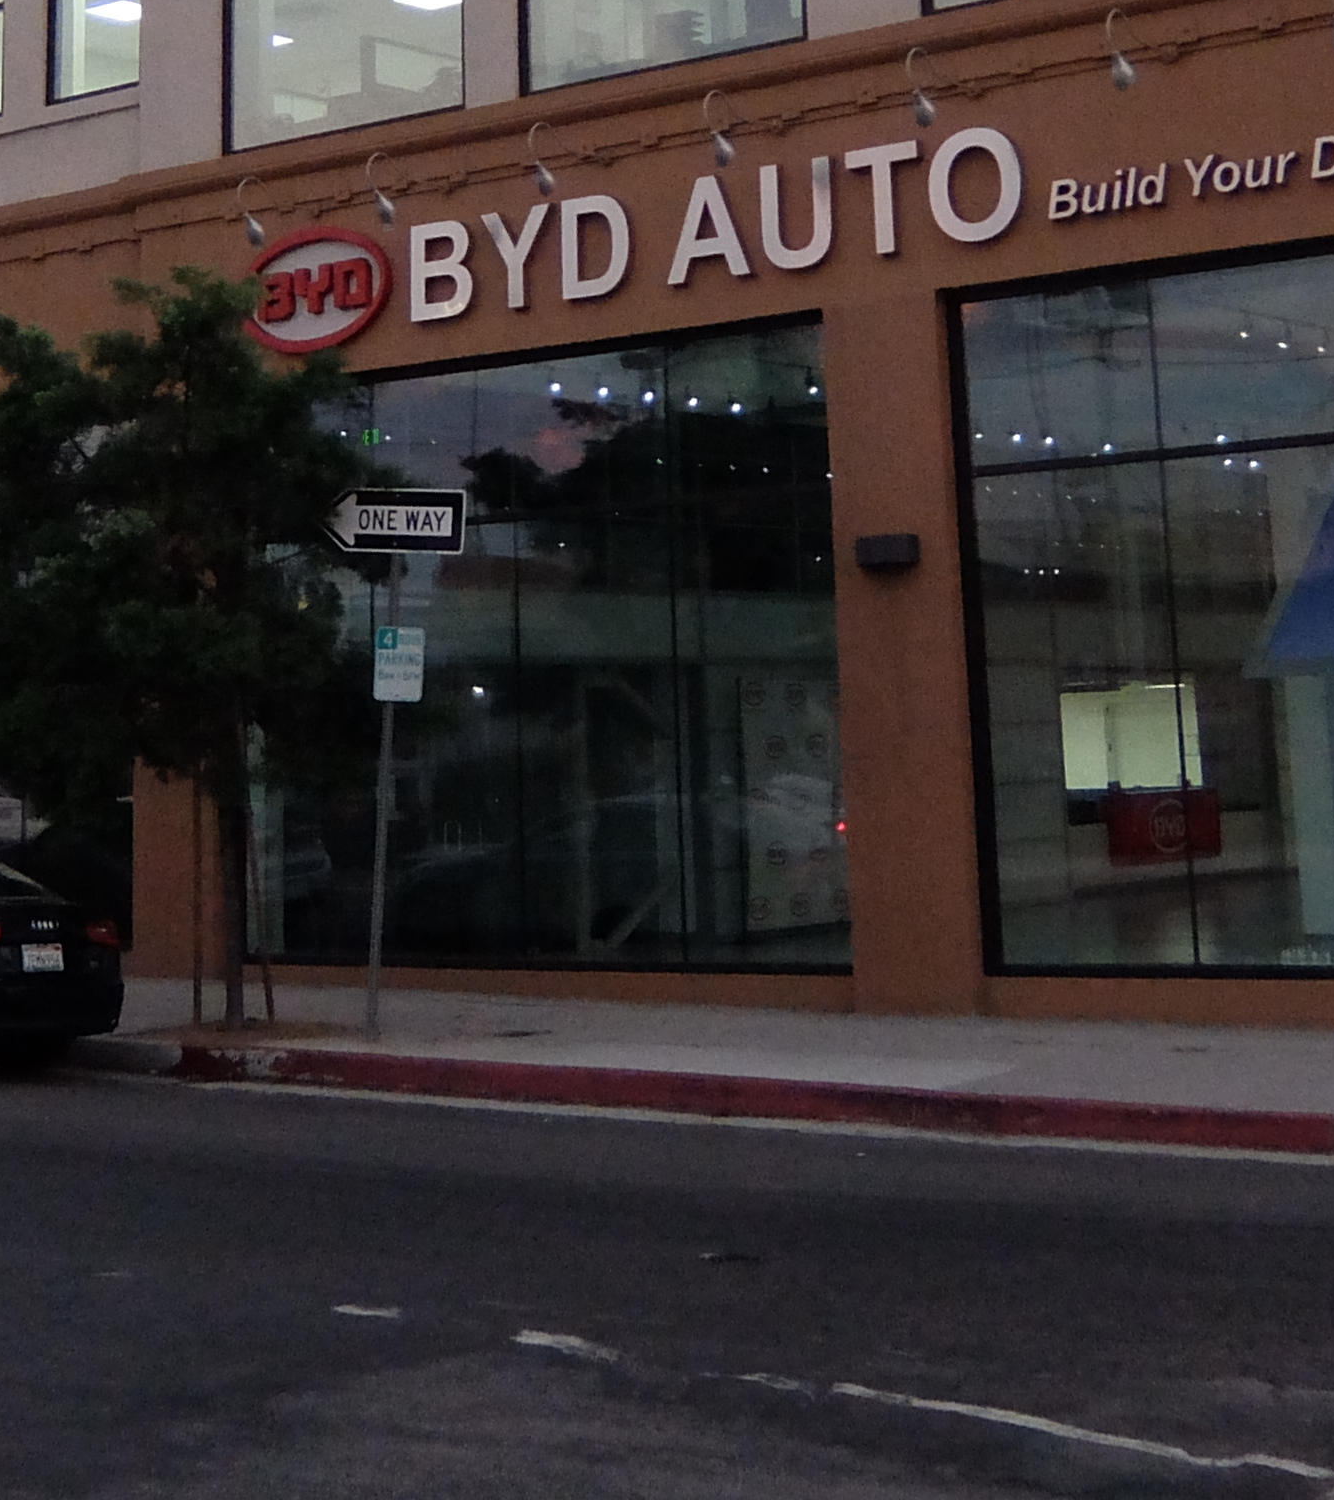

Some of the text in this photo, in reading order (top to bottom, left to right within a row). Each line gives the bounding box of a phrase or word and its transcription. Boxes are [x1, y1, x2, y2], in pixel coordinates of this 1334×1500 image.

[1048, 163, 1167, 221] Build
[1183, 151, 1298, 198] Your
[409, 127, 1022, 324] BYD AUTO
[257, 257, 373, 323] BYD
[358, 509, 446, 532] ONE WAY
[378, 652, 422, 667] PARKING
[383, 632, 394, 648] 4
